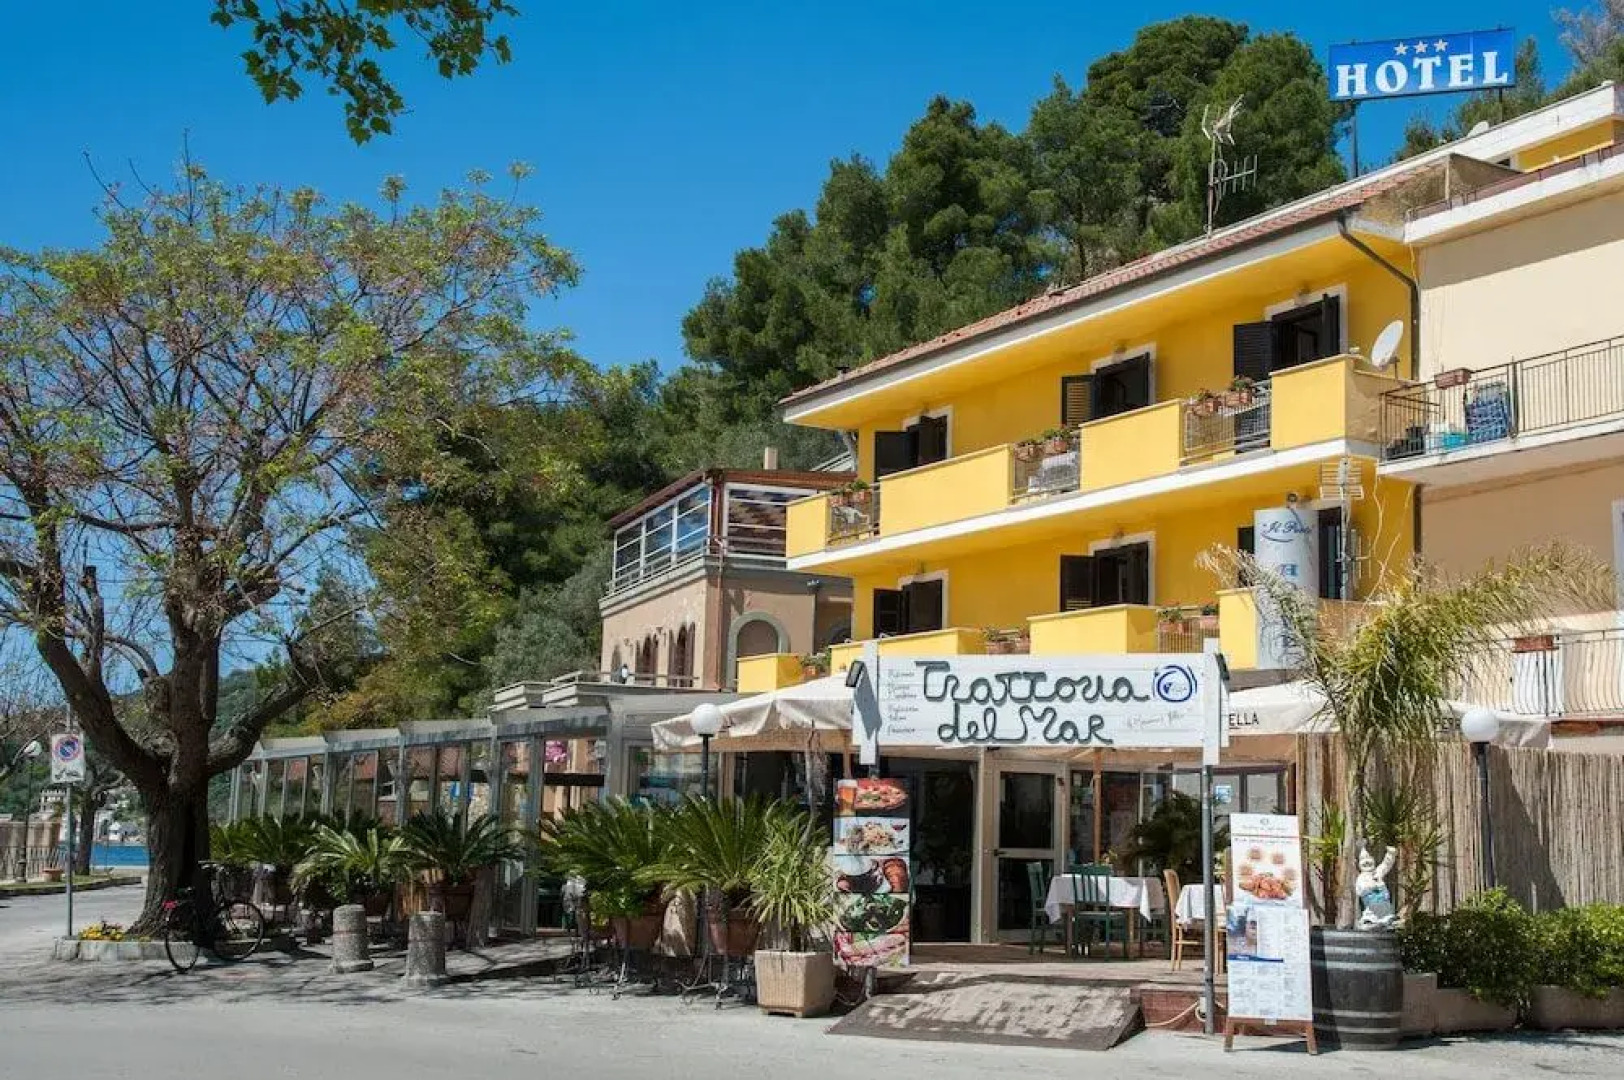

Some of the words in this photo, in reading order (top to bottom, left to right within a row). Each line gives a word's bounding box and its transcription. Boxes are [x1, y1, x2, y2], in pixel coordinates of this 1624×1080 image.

[1335, 51, 1508, 98] HOTEL
[937, 701, 998, 744] del
[1229, 710, 1259, 727] ELLA
